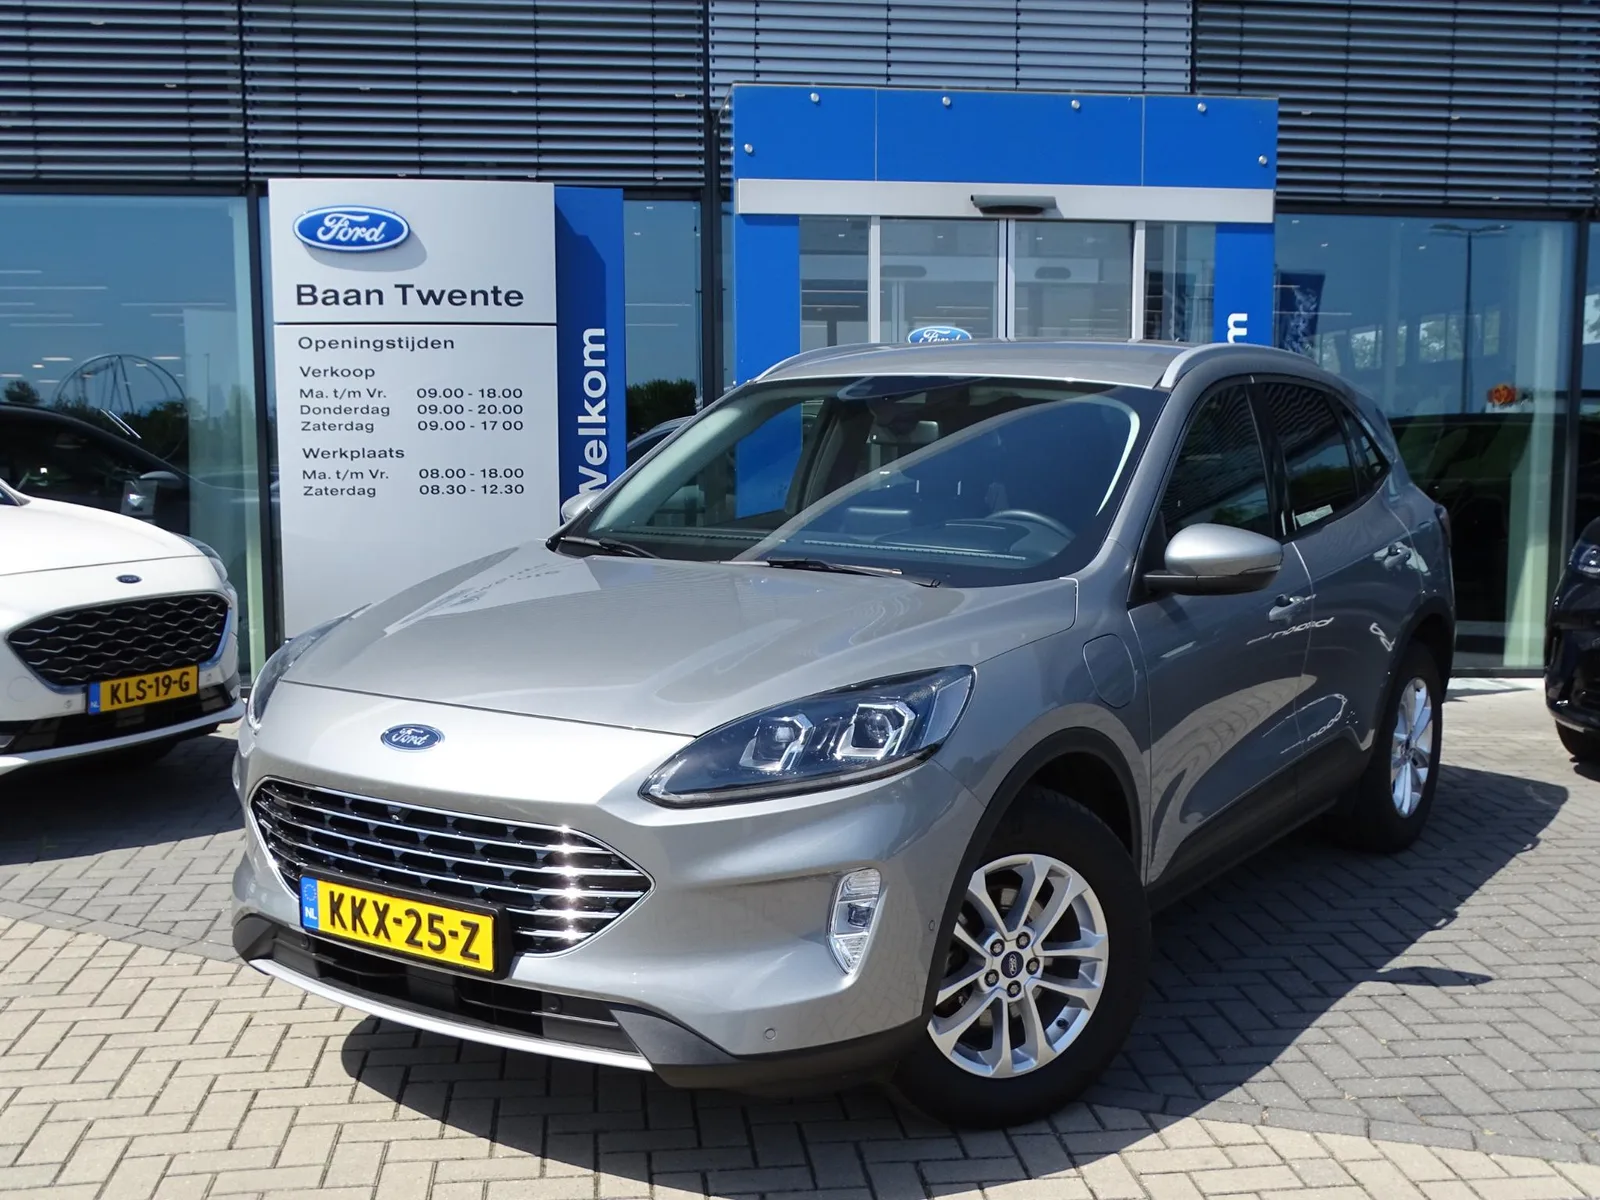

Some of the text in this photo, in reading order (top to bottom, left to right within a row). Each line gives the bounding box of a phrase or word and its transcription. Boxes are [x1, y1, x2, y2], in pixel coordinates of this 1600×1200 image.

[296, 283, 525, 307] Baan Twente
[297, 336, 455, 352] Openingstijden
[299, 366, 376, 380] Verkoop
[299, 388, 329, 399] Ma.
[333, 388, 362, 400] t/m
[366, 388, 387, 399] Vr.
[416, 388, 464, 399] 09.00
[478, 388, 523, 399] 18.00
[300, 404, 391, 417] Donderdag
[417, 404, 465, 415] 09.00
[477, 404, 524, 415] 20.00
[301, 421, 375, 434] Zaterdag
[418, 420, 466, 431] 09.00
[302, 447, 406, 461] Werkplaats
[302, 469, 332, 480] Ma.
[335, 469, 365, 481] t/m
[368, 469, 390, 479] Vr.
[419, 468, 467, 479] 08.00
[480, 468, 525, 478] 18.00
[303, 485, 377, 498] Zaterdag
[419, 484, 467, 495] 08.30
[481, 484, 525, 495] 12.30
[110, 671, 190, 706] KLS-19-G
[304, 890, 482, 963] NL KKX-25-Z
